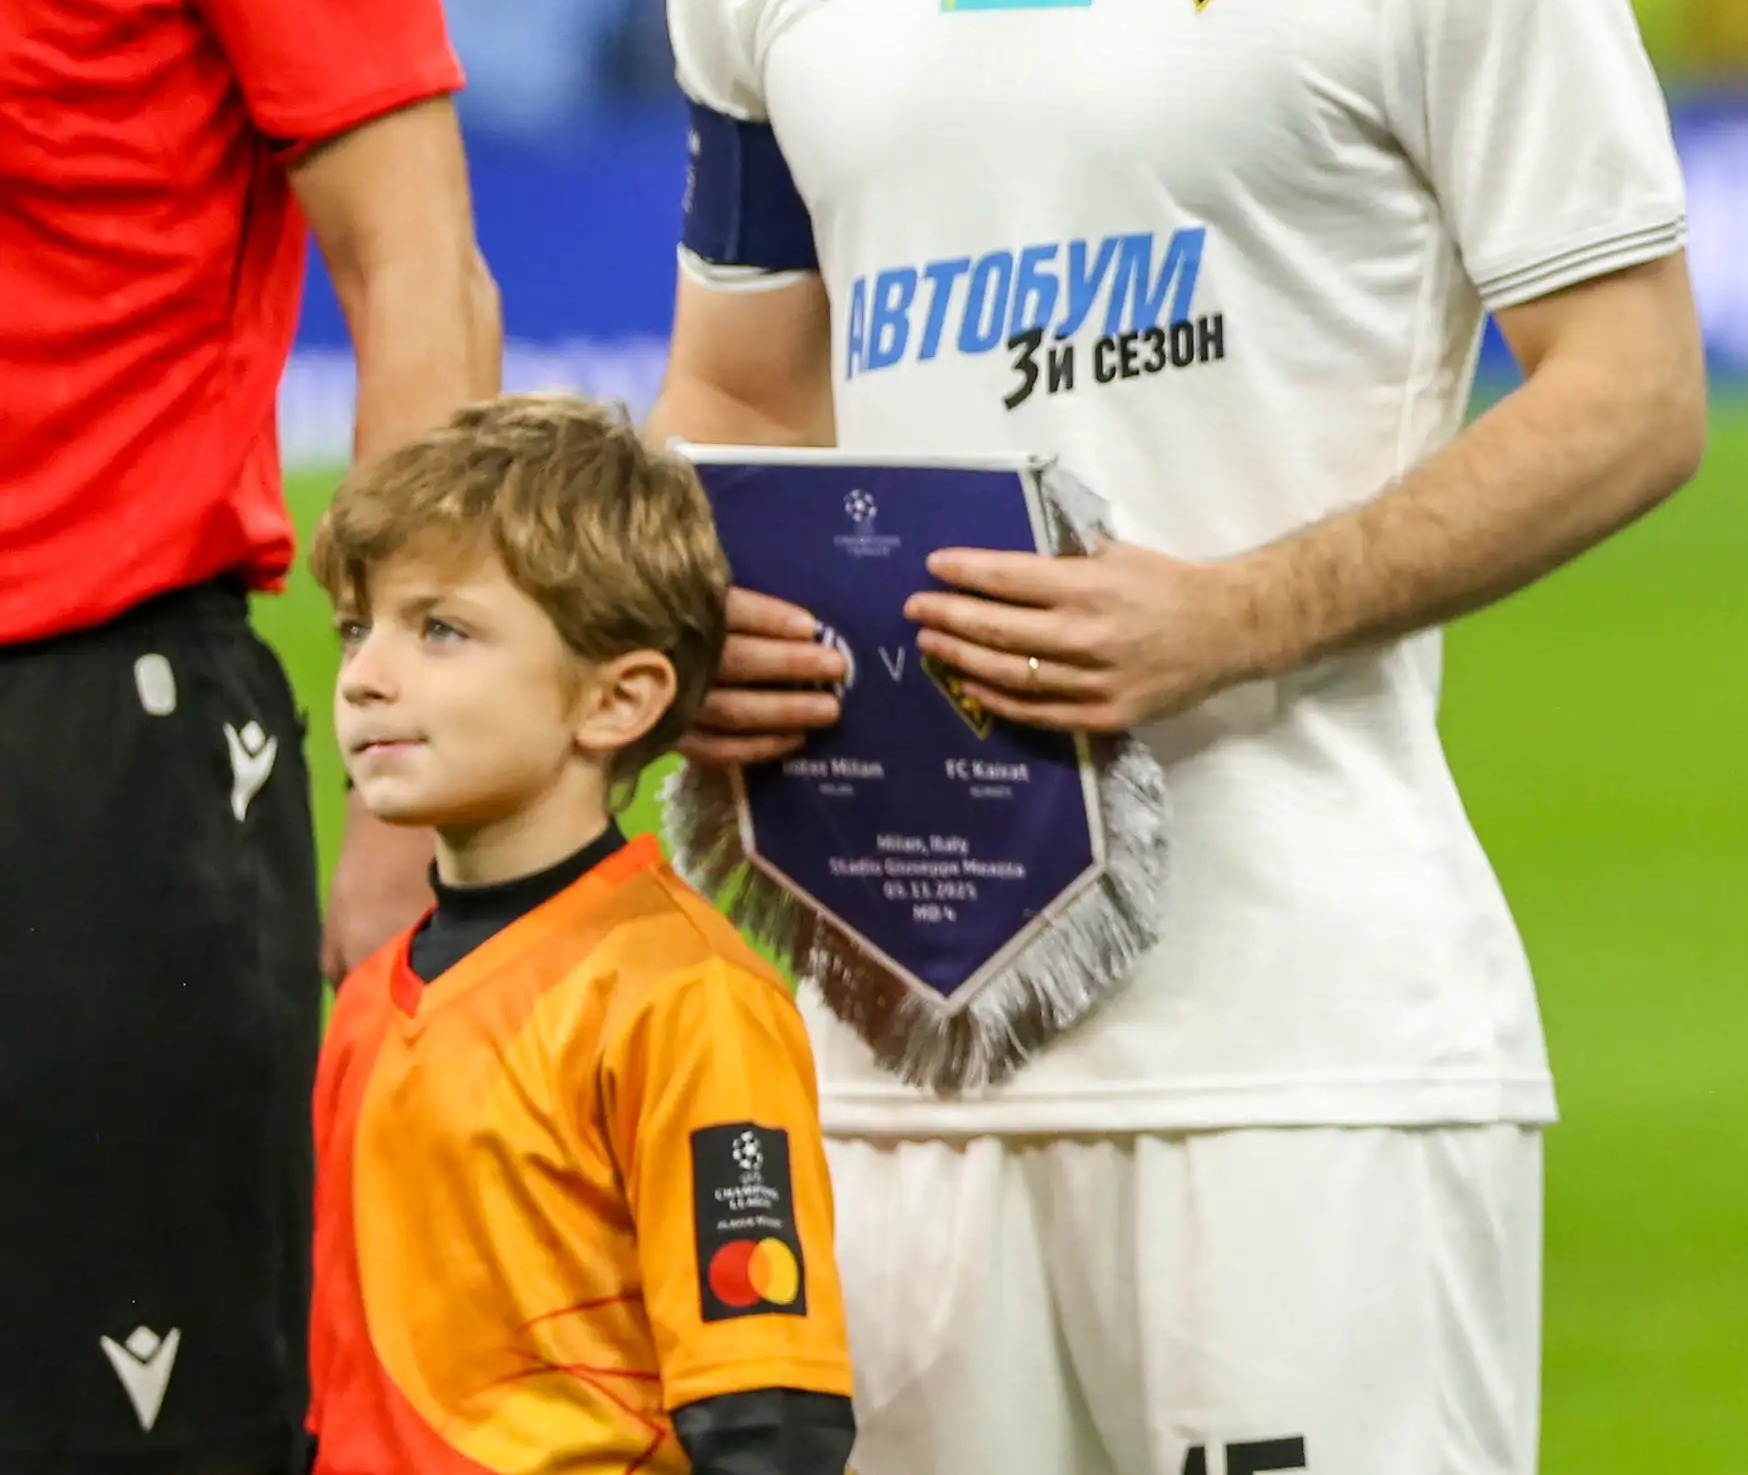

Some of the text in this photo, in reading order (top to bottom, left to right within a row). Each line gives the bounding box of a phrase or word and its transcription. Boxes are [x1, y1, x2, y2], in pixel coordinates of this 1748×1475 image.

[846, 228, 1206, 380] АВТОБУМ
[1093, 312, 1225, 384] СЕЗОН
[944, 758, 970, 781] FC
